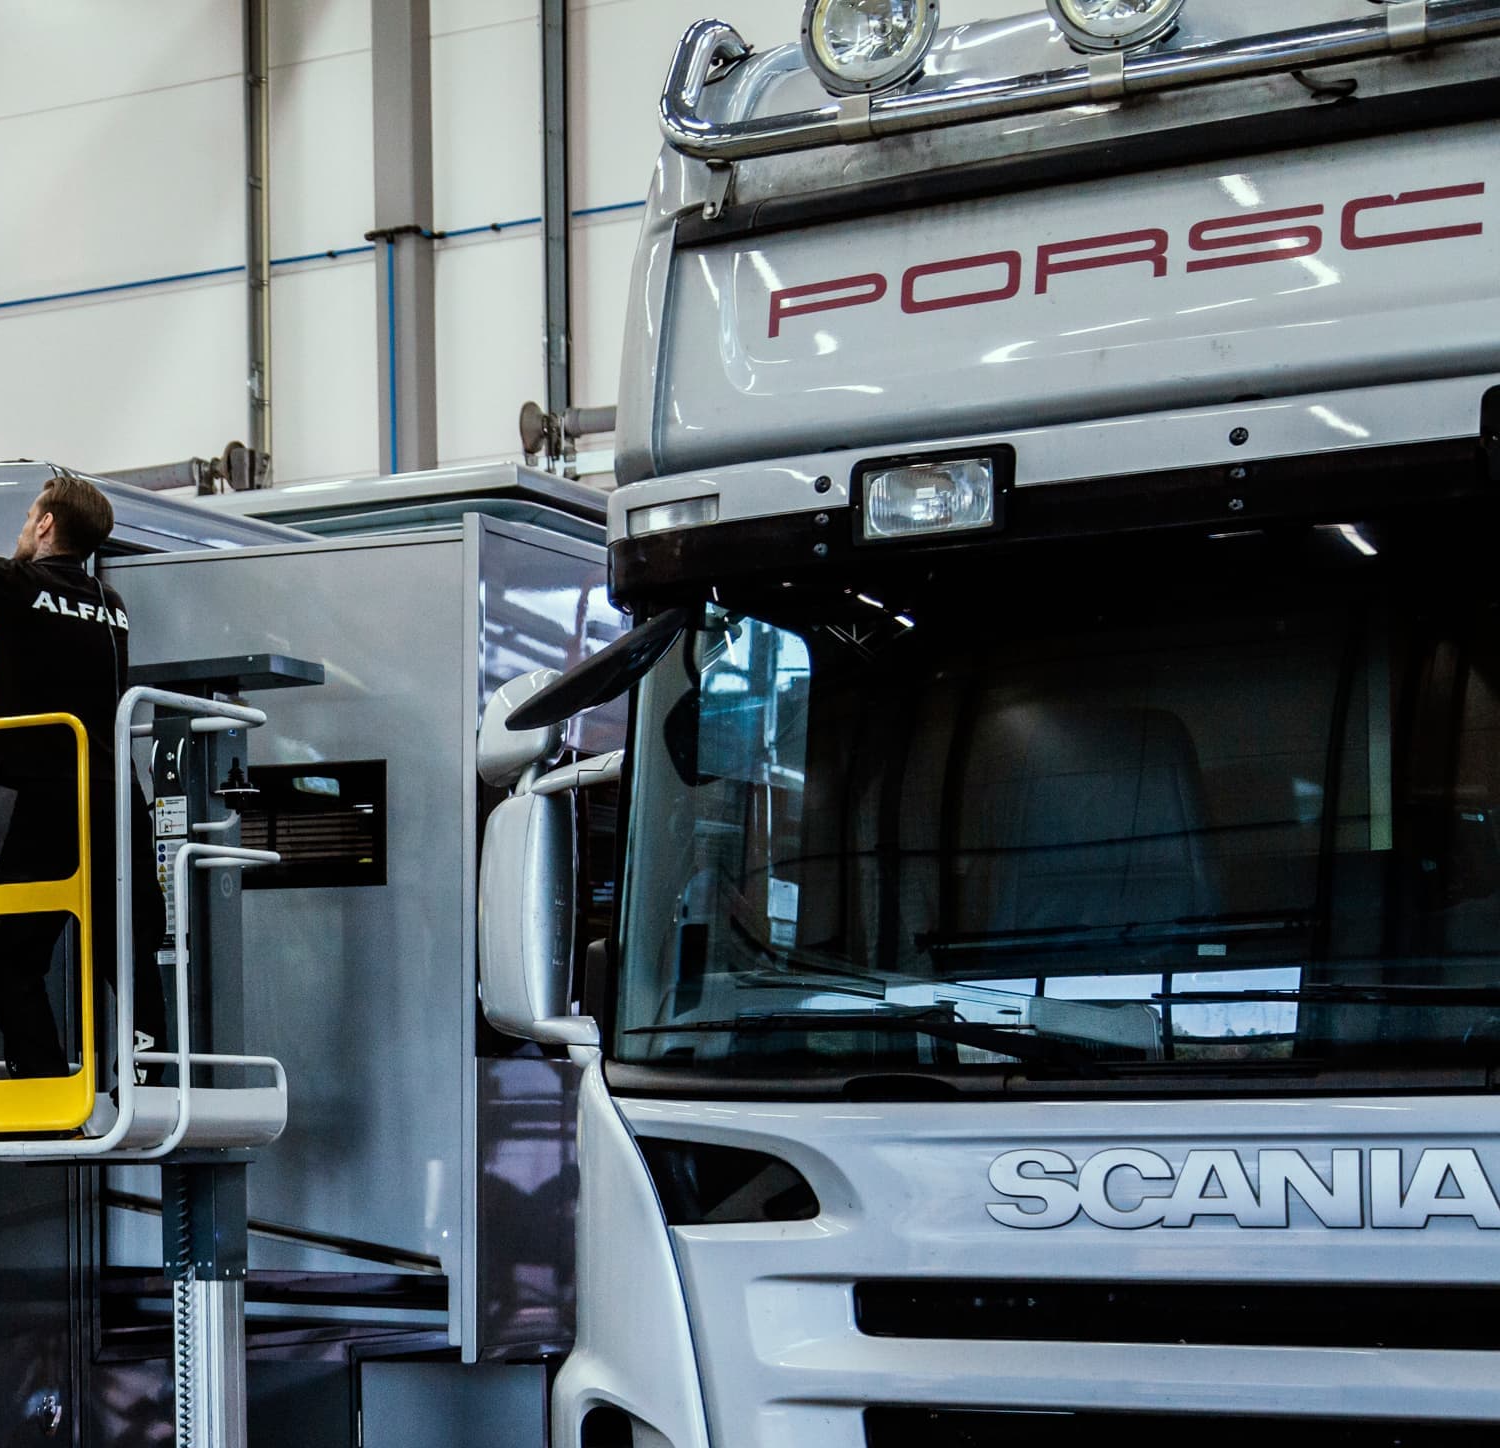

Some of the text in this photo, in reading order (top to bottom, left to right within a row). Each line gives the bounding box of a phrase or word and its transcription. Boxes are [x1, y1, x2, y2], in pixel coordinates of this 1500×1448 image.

[767, 182, 1484, 338] PORSC
[32, 590, 129, 631] ALFAB
[986, 1148, 1500, 1230] SCANIA
